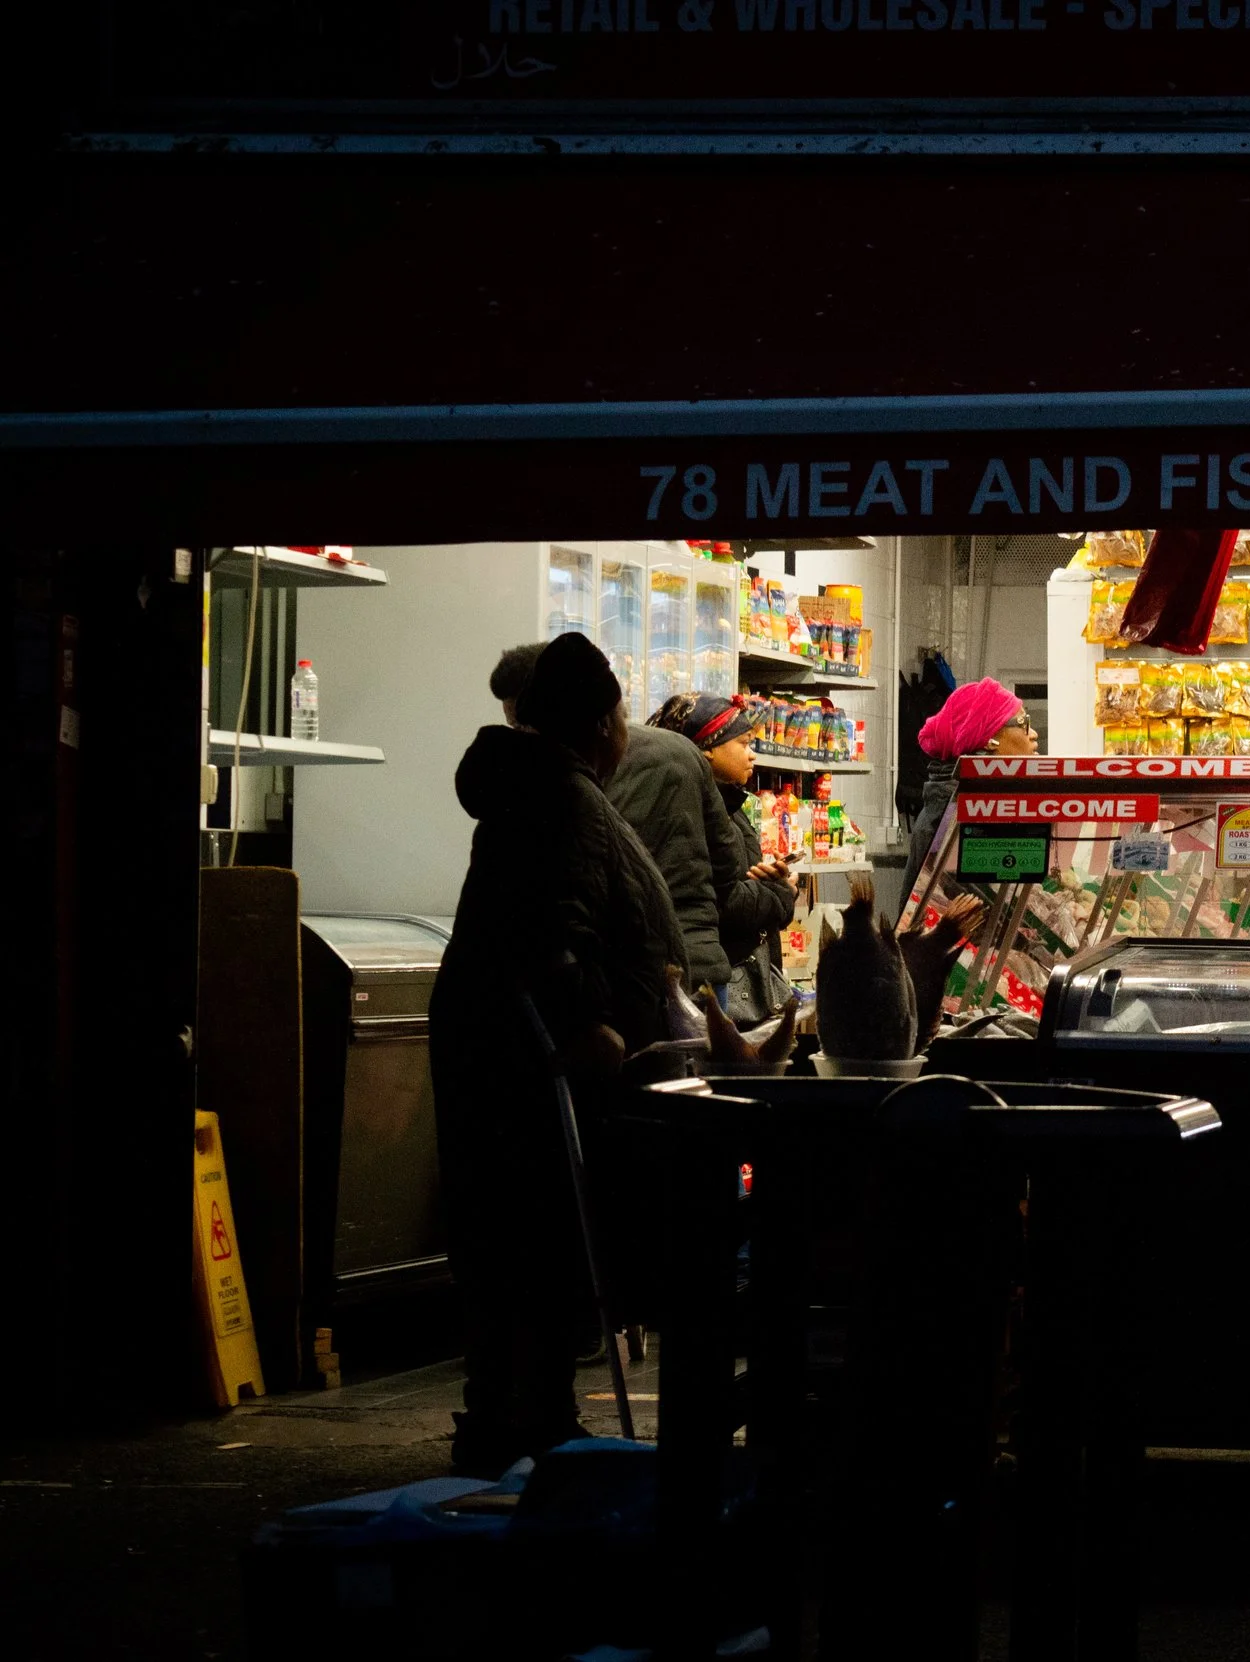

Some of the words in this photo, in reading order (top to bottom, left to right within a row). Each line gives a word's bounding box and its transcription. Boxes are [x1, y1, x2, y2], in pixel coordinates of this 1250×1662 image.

[489, 0, 661, 33] RETAIL
[676, 0, 714, 32] &
[735, 0, 1048, 32] WHOLESALE
[428, 31, 558, 91] حلال
[639, 463, 719, 521] 78
[745, 458, 951, 520] MEAT
[968, 455, 1133, 517] AND
[964, 799, 1137, 818] WELCOME
[1006, 857, 1013, 867] 3
